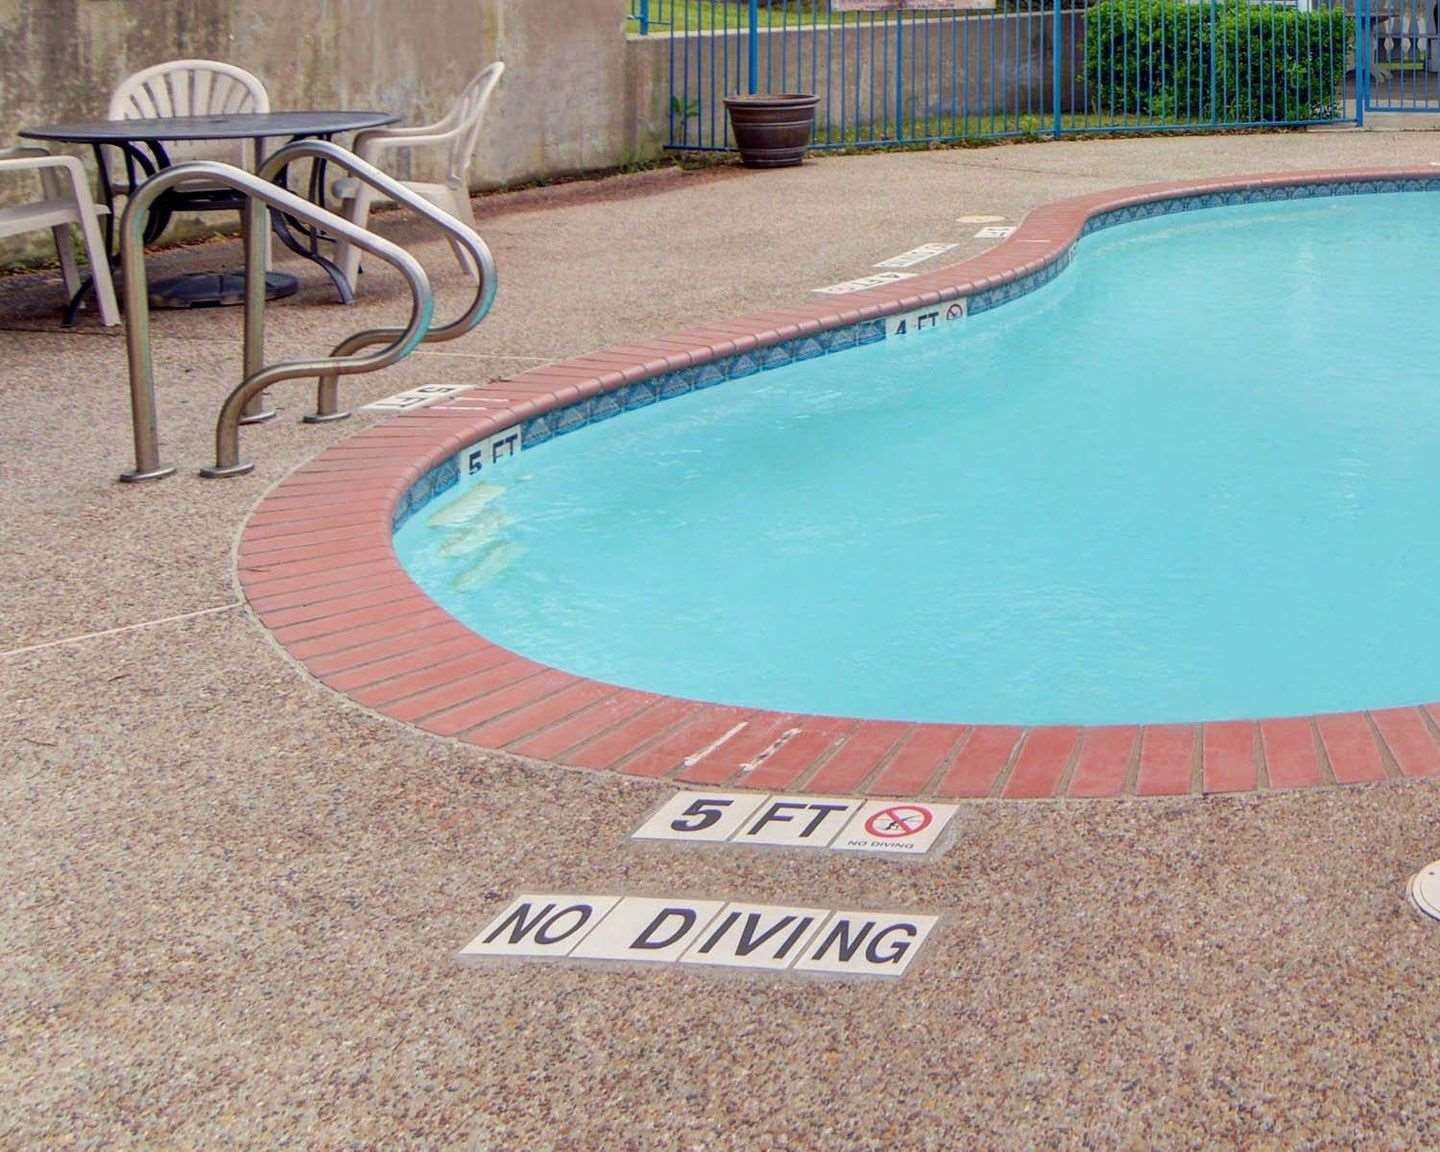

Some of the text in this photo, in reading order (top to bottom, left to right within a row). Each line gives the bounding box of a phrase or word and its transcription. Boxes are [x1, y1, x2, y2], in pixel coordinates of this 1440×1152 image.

[895, 320, 907, 334] 4
[468, 433, 518, 475] 5 FT
[670, 799, 850, 839] 5 FT
[871, 841, 914, 849] DIVING
[482, 902, 919, 965] NO DIVING
